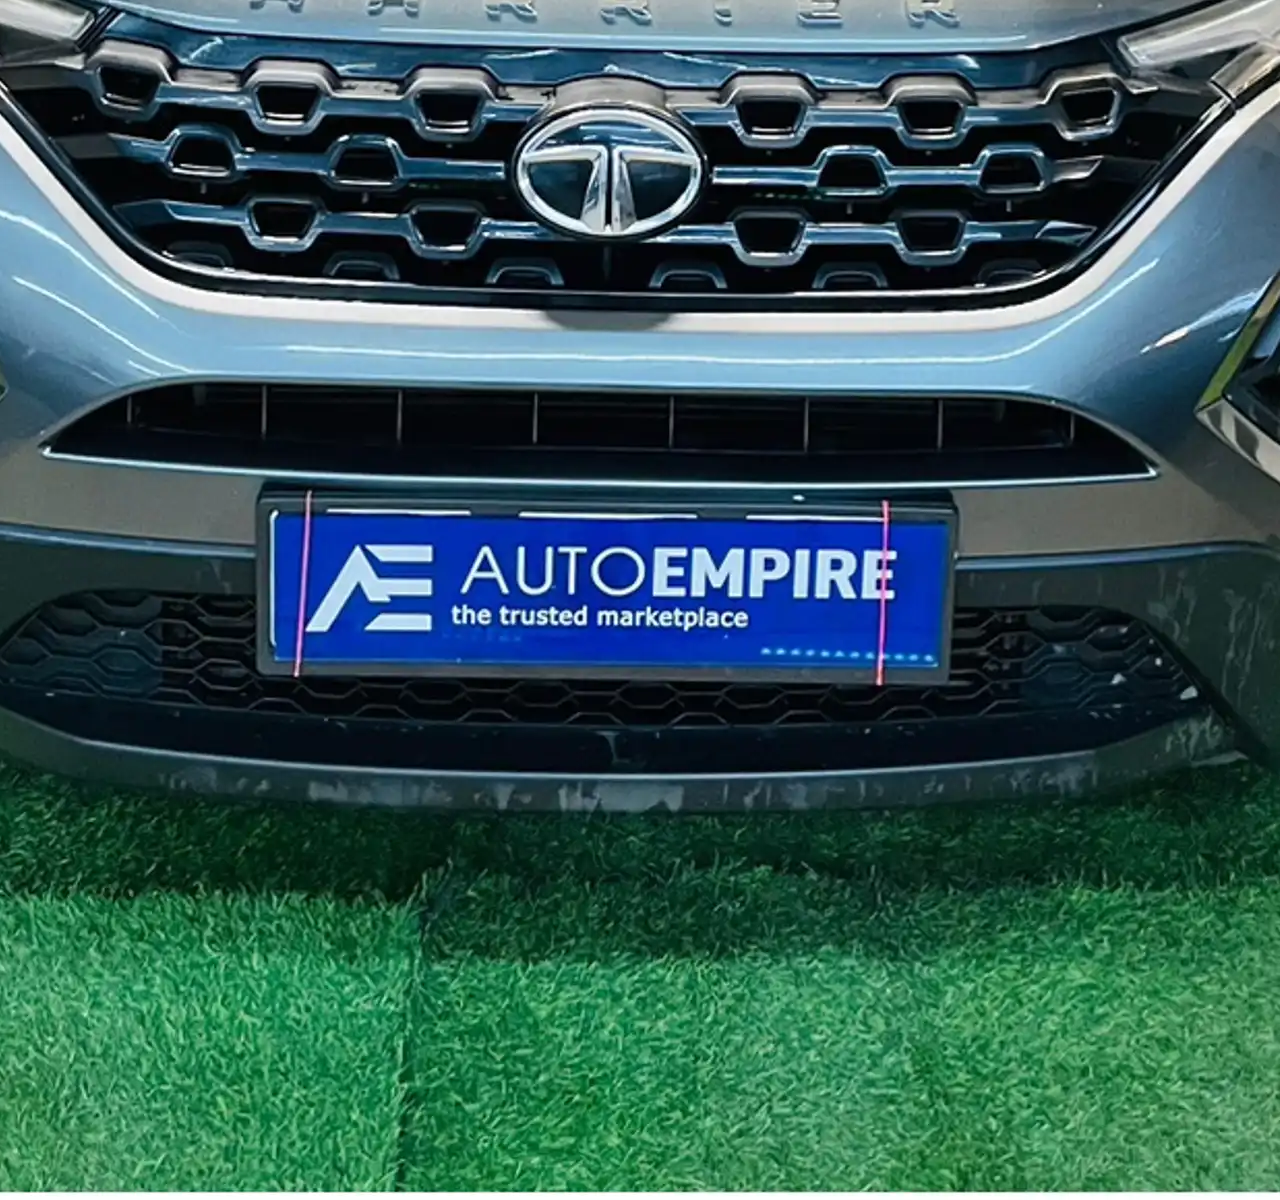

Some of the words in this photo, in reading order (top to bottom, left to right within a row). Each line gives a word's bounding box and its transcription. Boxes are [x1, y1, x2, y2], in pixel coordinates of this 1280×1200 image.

[460, 545, 898, 601] AUTOEMPIRE
[451, 605, 492, 626] the
[499, 605, 588, 627] trusted
[596, 606, 750, 632] marketplace
